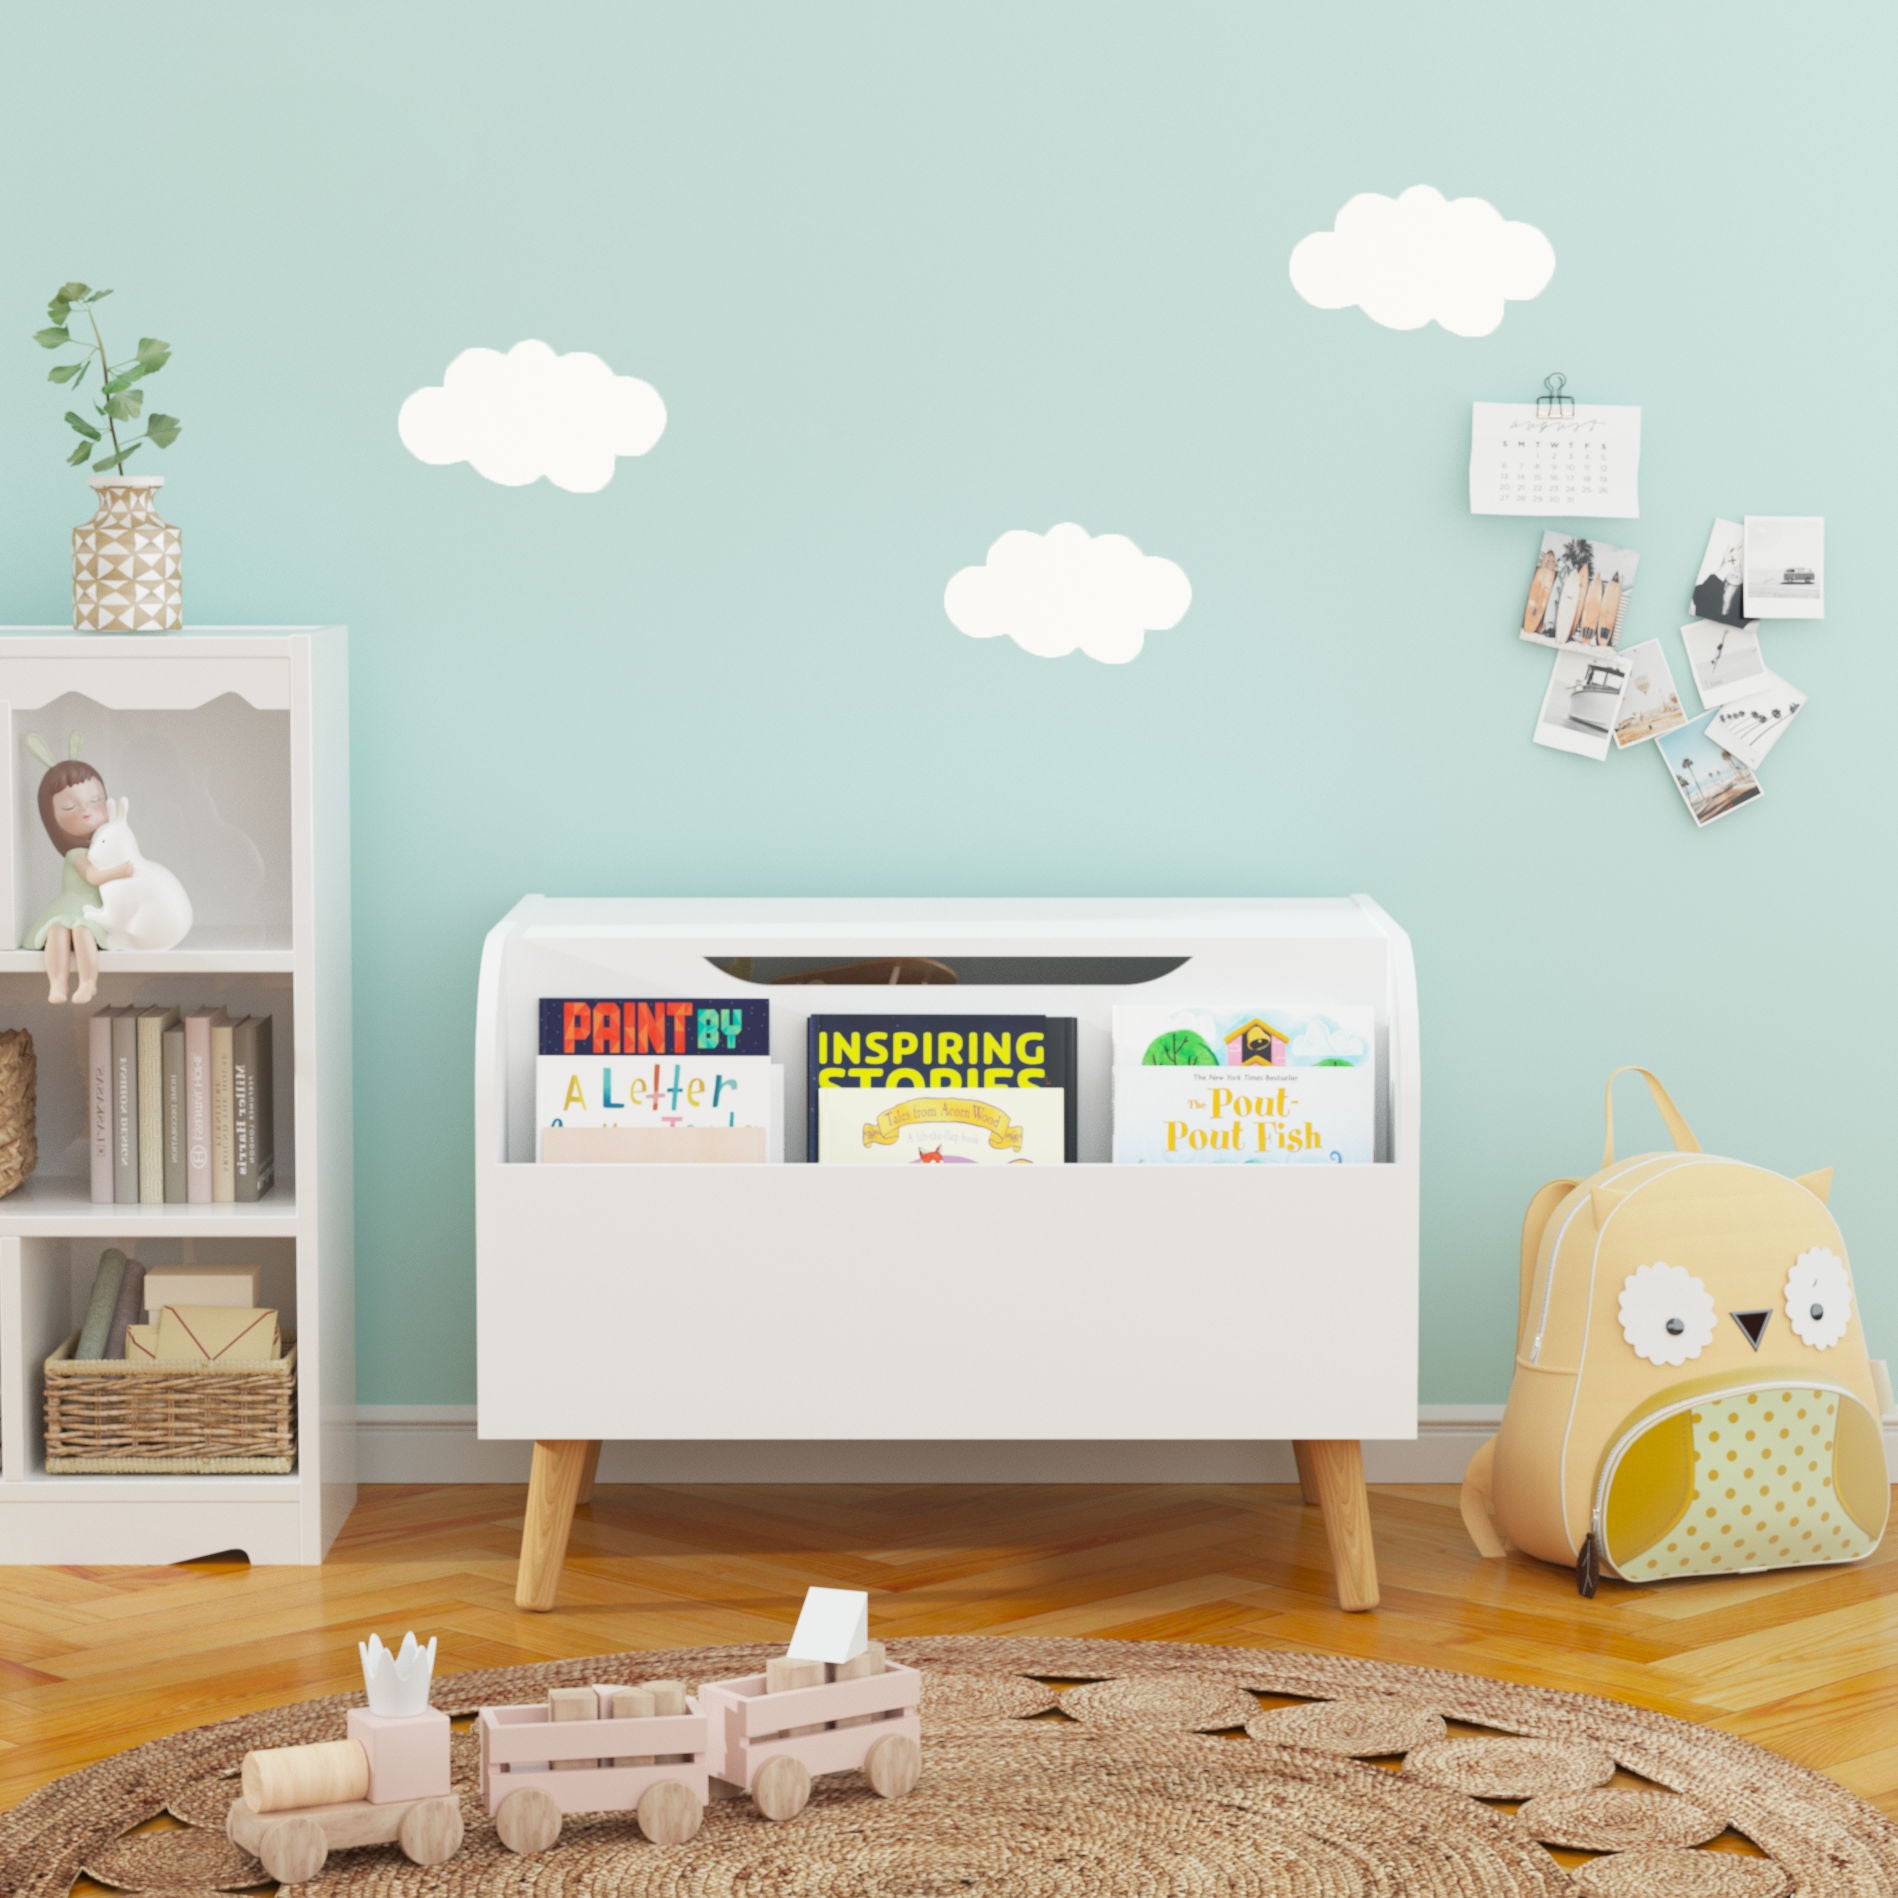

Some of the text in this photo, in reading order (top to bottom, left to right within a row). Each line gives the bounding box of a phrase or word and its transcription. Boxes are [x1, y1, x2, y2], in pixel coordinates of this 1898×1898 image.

[563, 1002, 742, 1054] PAINT BY
[818, 1031, 1045, 1065] INSPIRING
[563, 1063, 738, 1111] A Letter
[1187, 1087, 1299, 1119] The Pout-
[885, 1102, 1001, 1128] Tales from Acorn Wood
[1162, 1120, 1323, 1152] Pout Fish
